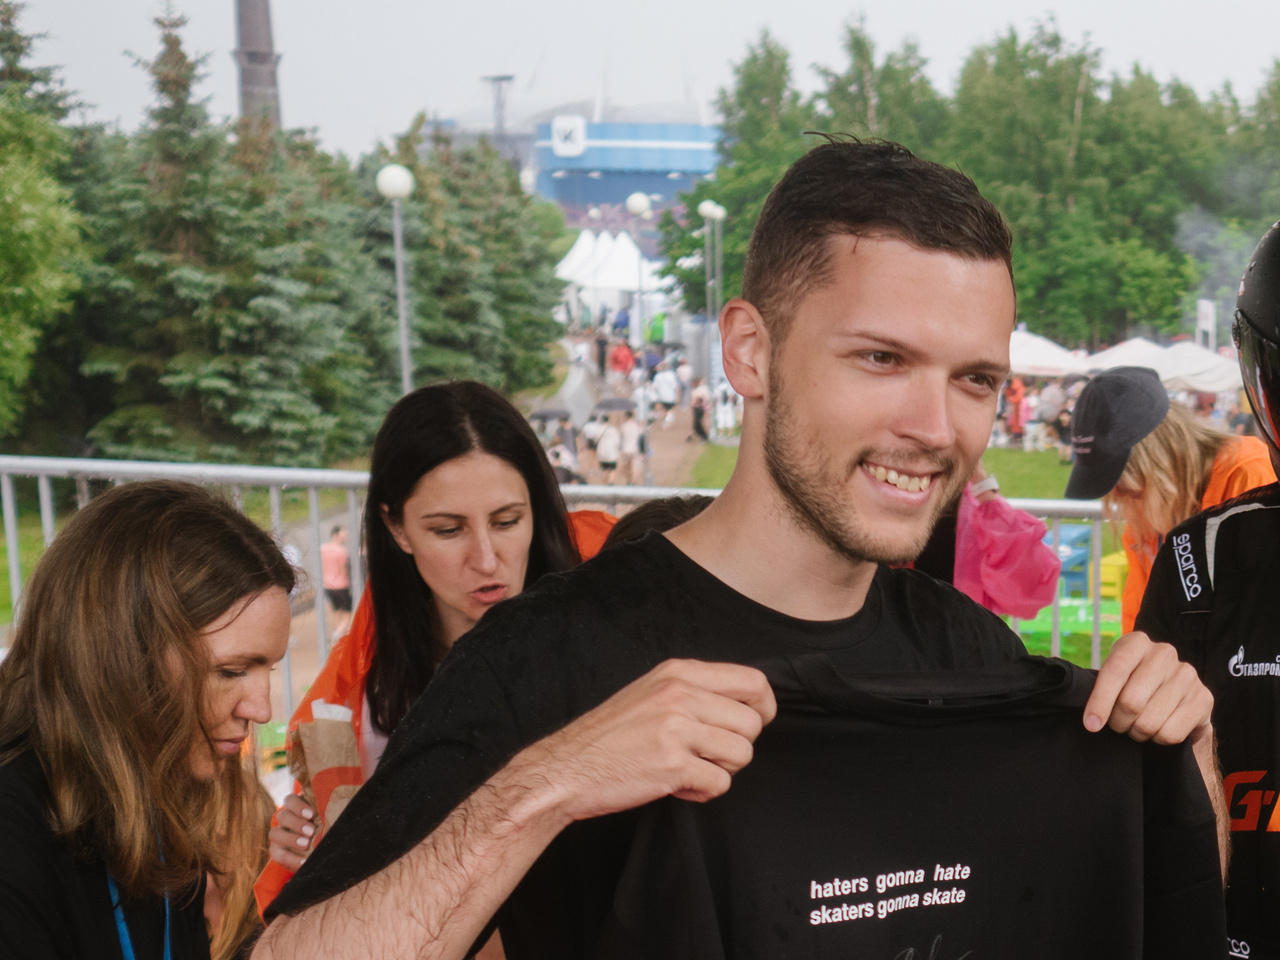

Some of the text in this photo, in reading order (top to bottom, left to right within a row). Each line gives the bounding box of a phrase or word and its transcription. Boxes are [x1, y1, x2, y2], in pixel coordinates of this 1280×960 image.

[1173, 533, 1201, 601] sparco
[810, 863, 971, 899] haters gonna hate
[810, 887, 966, 925] skaters gonna skate
